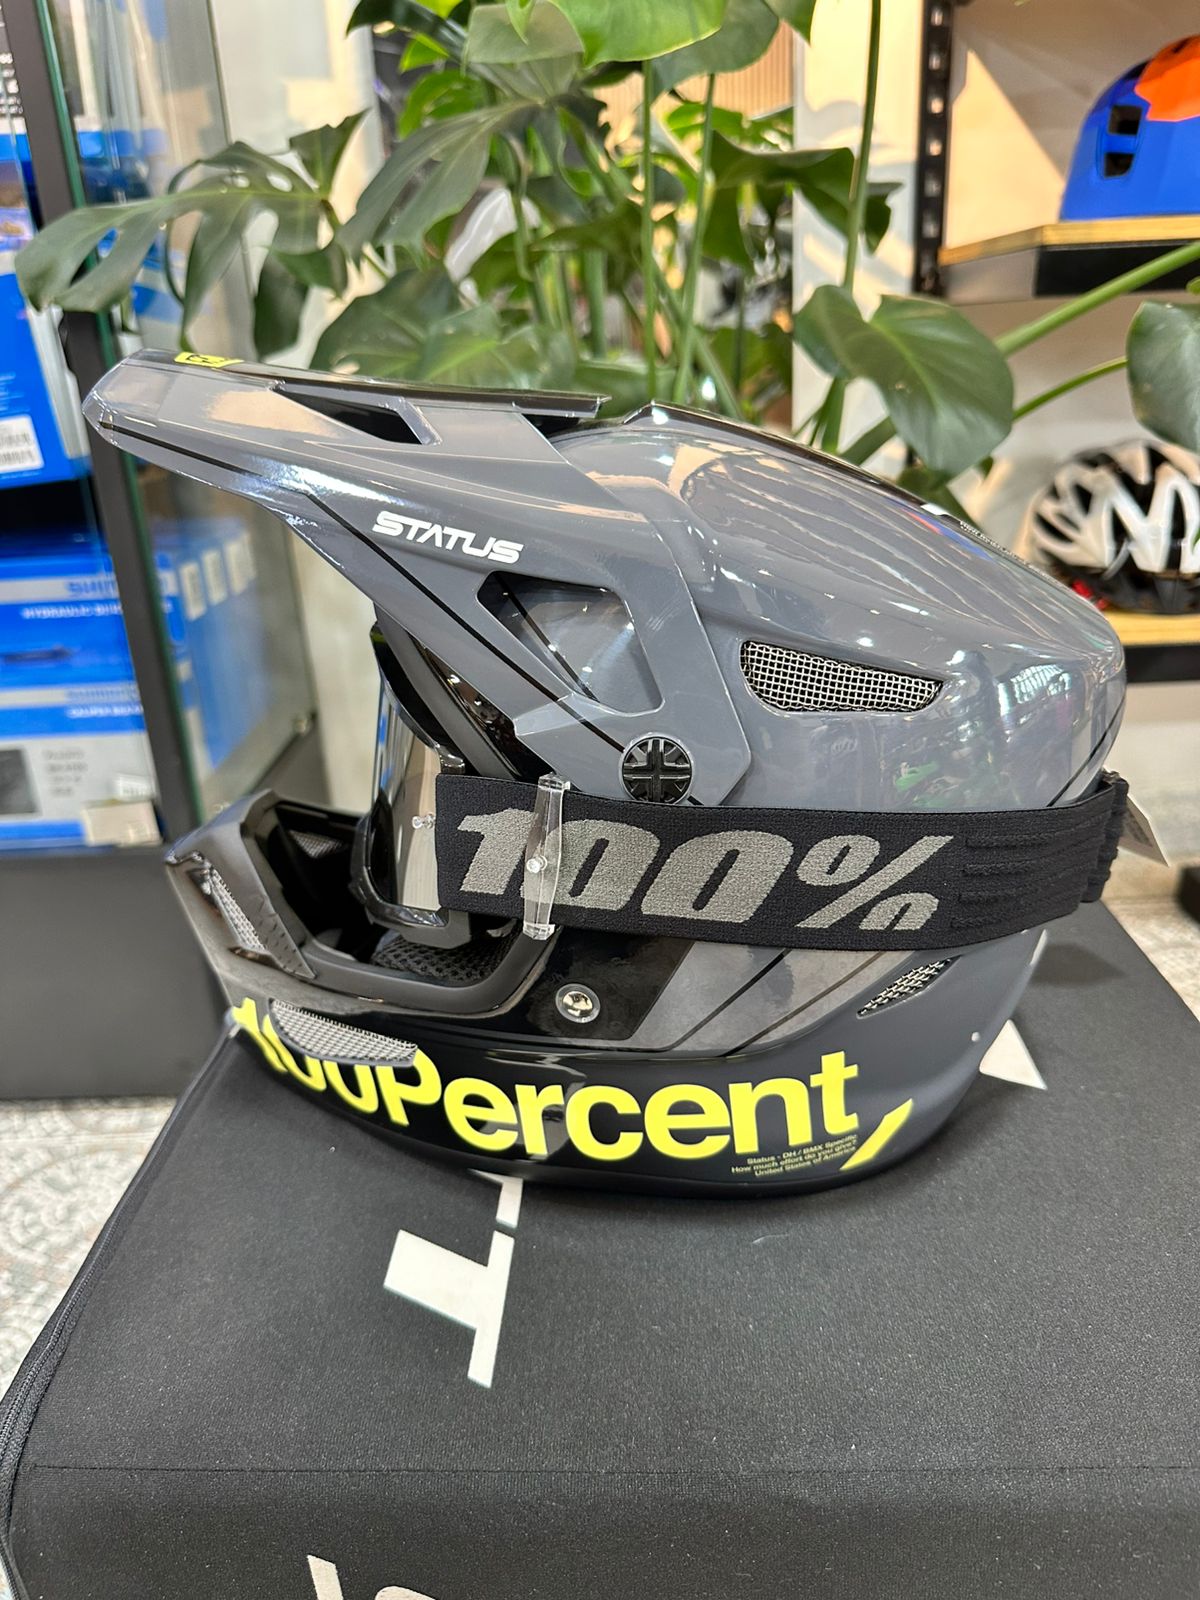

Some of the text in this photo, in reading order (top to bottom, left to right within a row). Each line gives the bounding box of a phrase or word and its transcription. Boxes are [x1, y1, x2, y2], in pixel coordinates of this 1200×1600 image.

[372, 510, 525, 564] STATUS
[457, 807, 954, 931] 100%
[731, 1138, 857, 1174] How much effort do you give?
[747, 1155, 776, 1165] Status
[825, 1134, 857, 1148] Specific
[755, 1146, 856, 1176] United States of America
